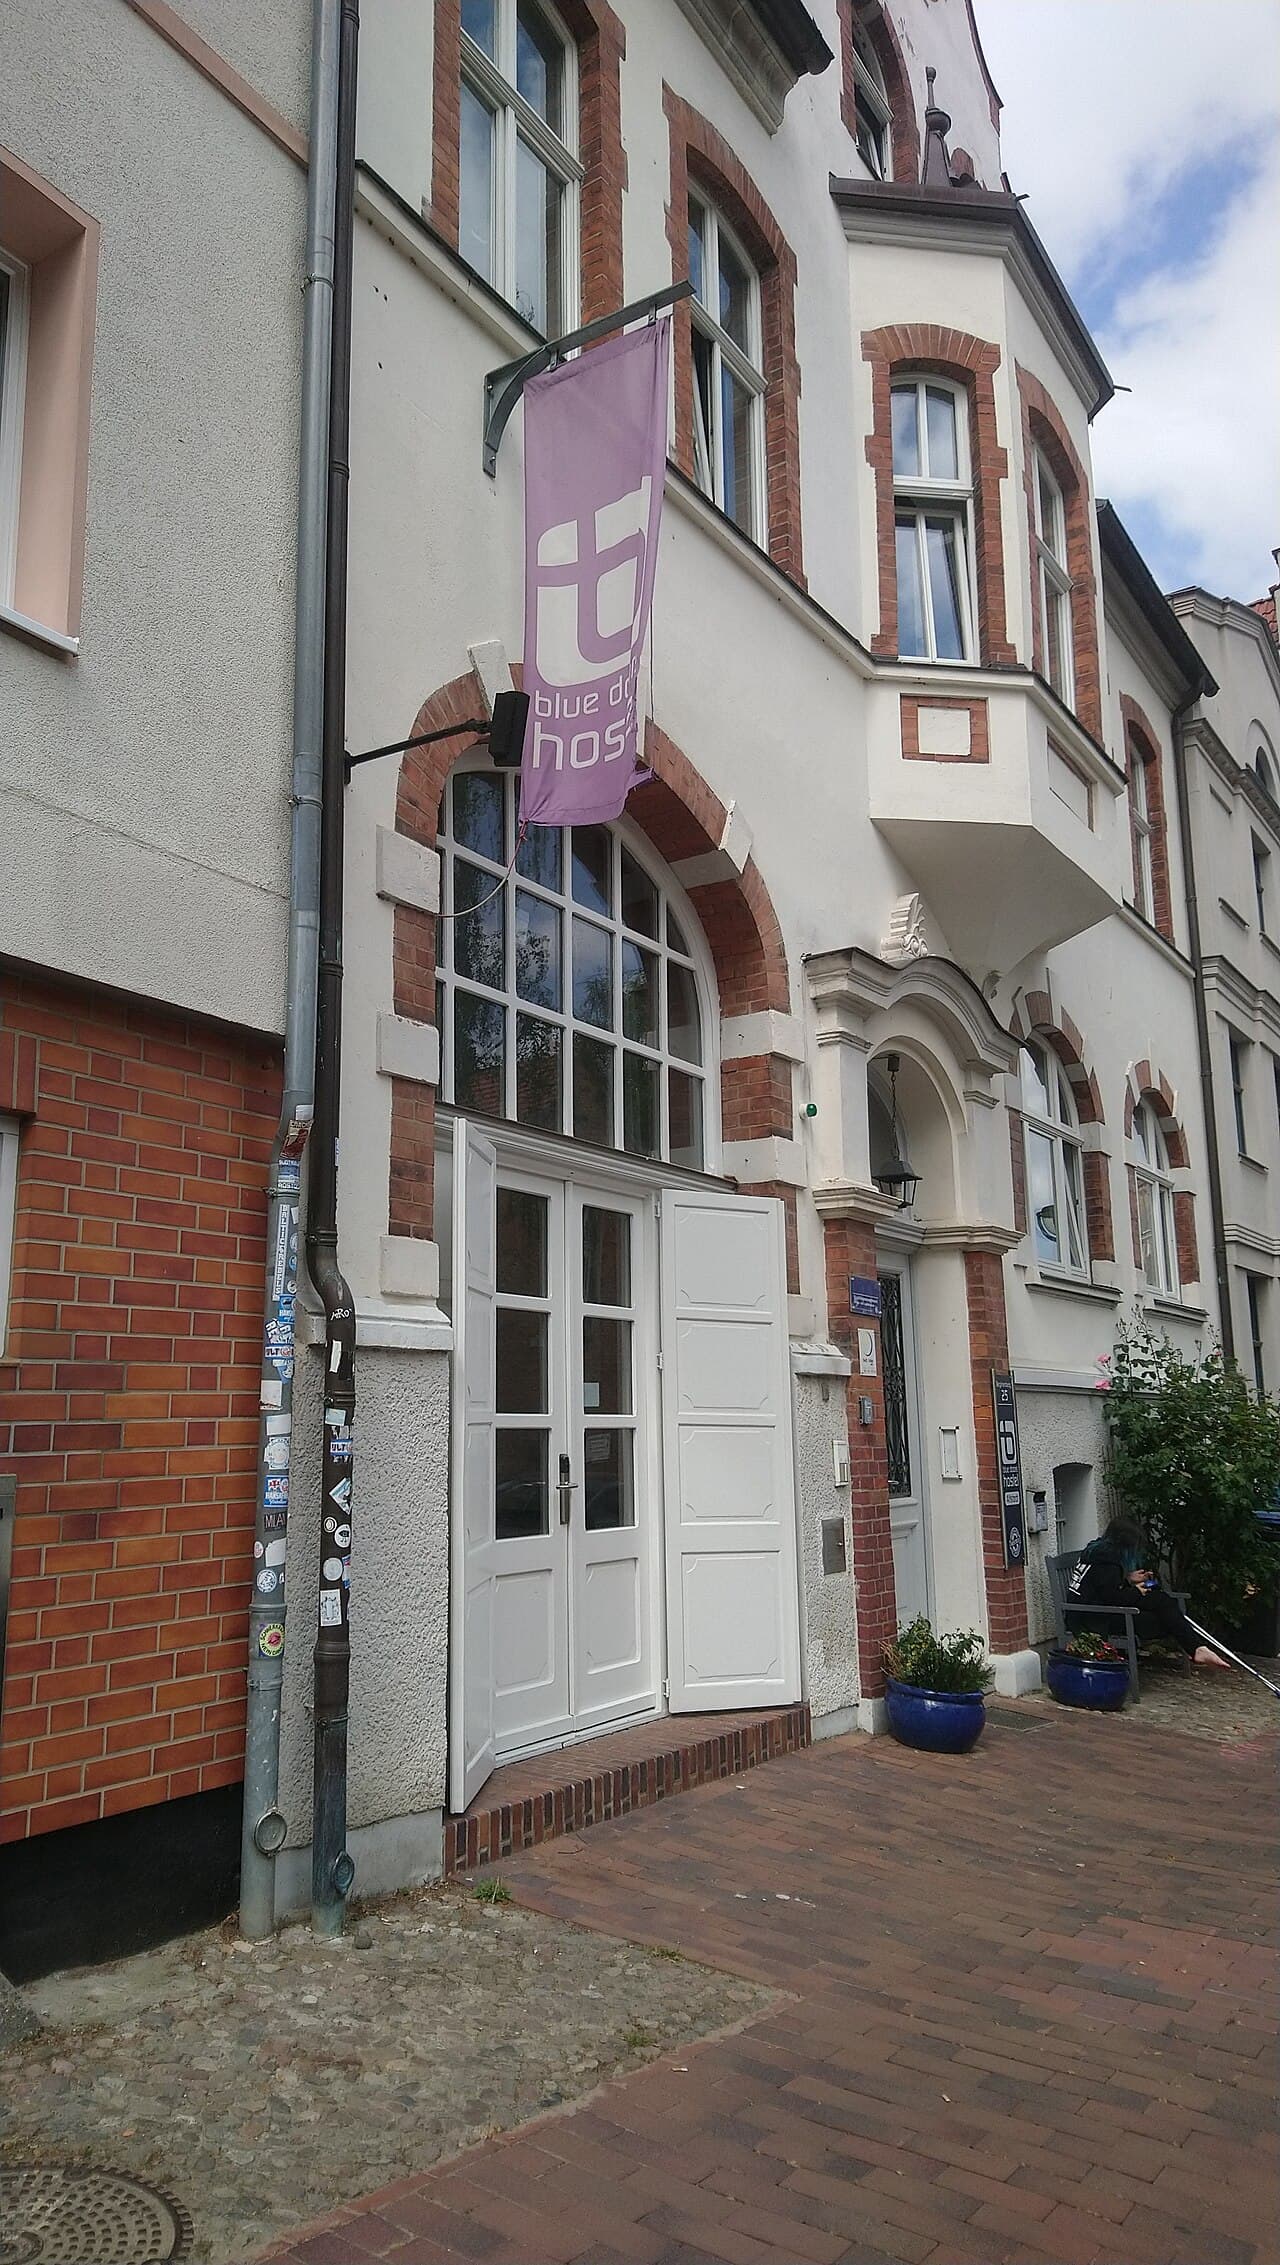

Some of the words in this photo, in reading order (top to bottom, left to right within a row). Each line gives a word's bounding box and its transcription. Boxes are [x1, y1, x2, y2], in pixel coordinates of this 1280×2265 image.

[535, 690, 598, 719] blue
[532, 716, 630, 770] hos
[1003, 1474, 1019, 1488] hostel
